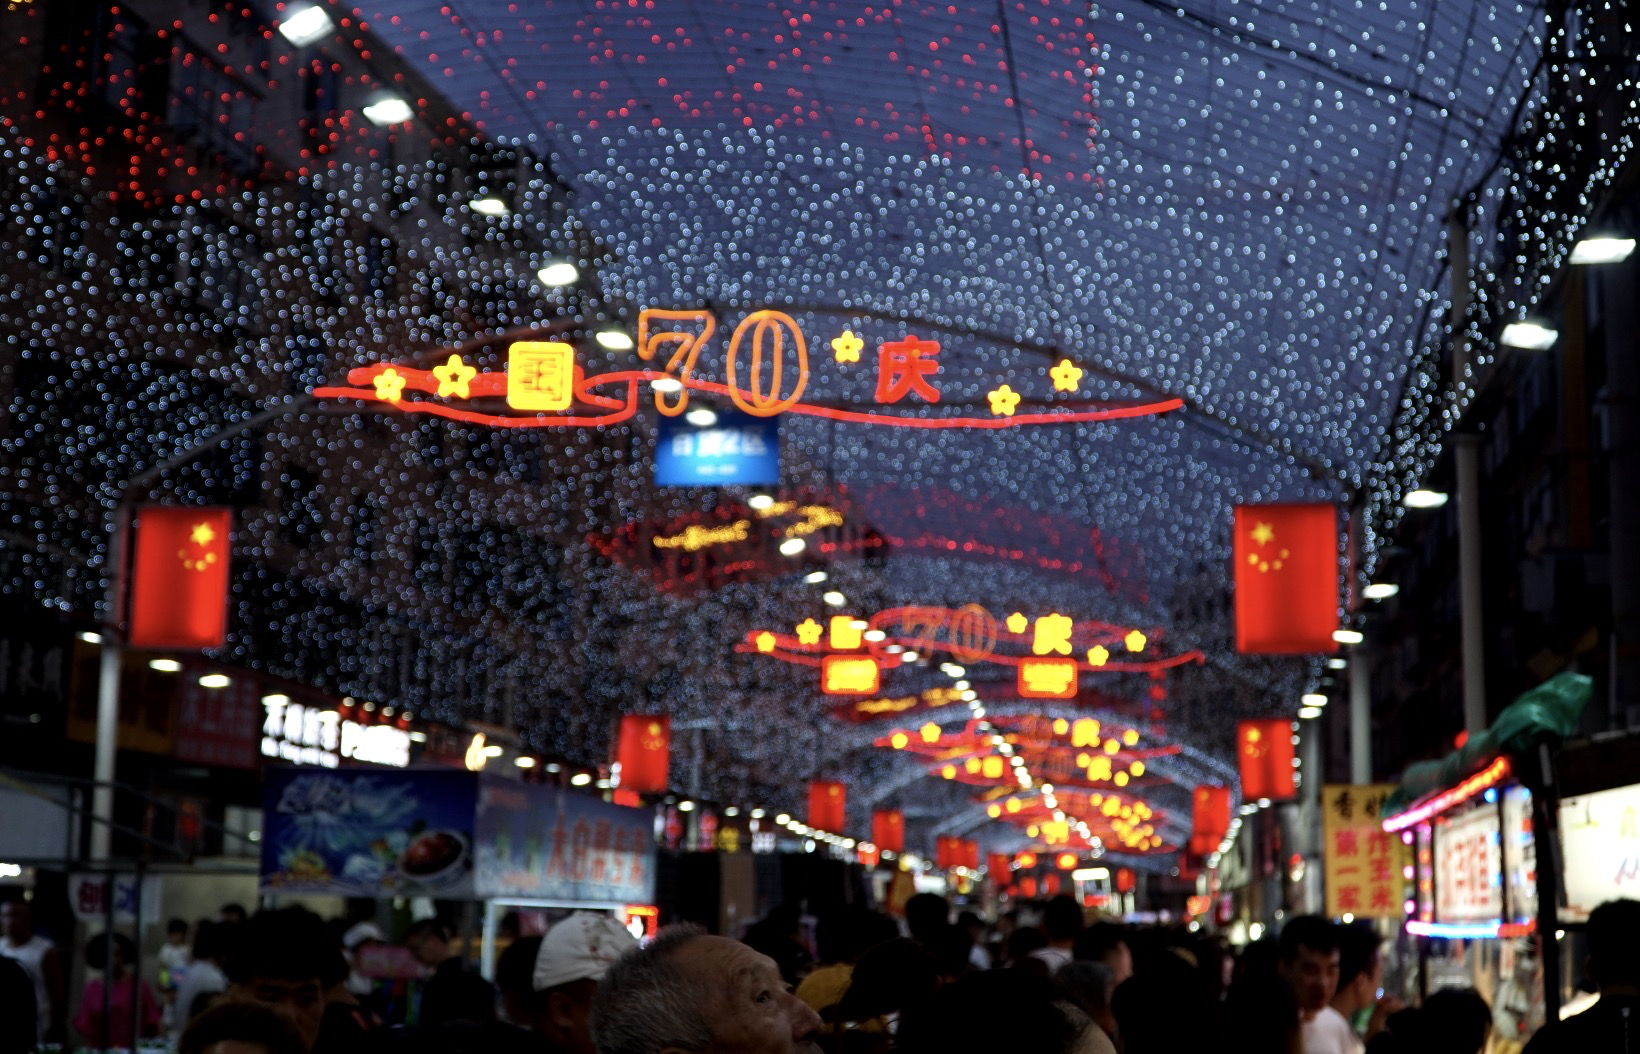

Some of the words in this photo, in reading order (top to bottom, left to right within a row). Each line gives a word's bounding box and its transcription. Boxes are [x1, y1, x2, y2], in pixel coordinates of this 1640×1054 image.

[508, 341, 574, 411] 国
[637, 308, 810, 418] 70
[875, 337, 942, 404] 庆
